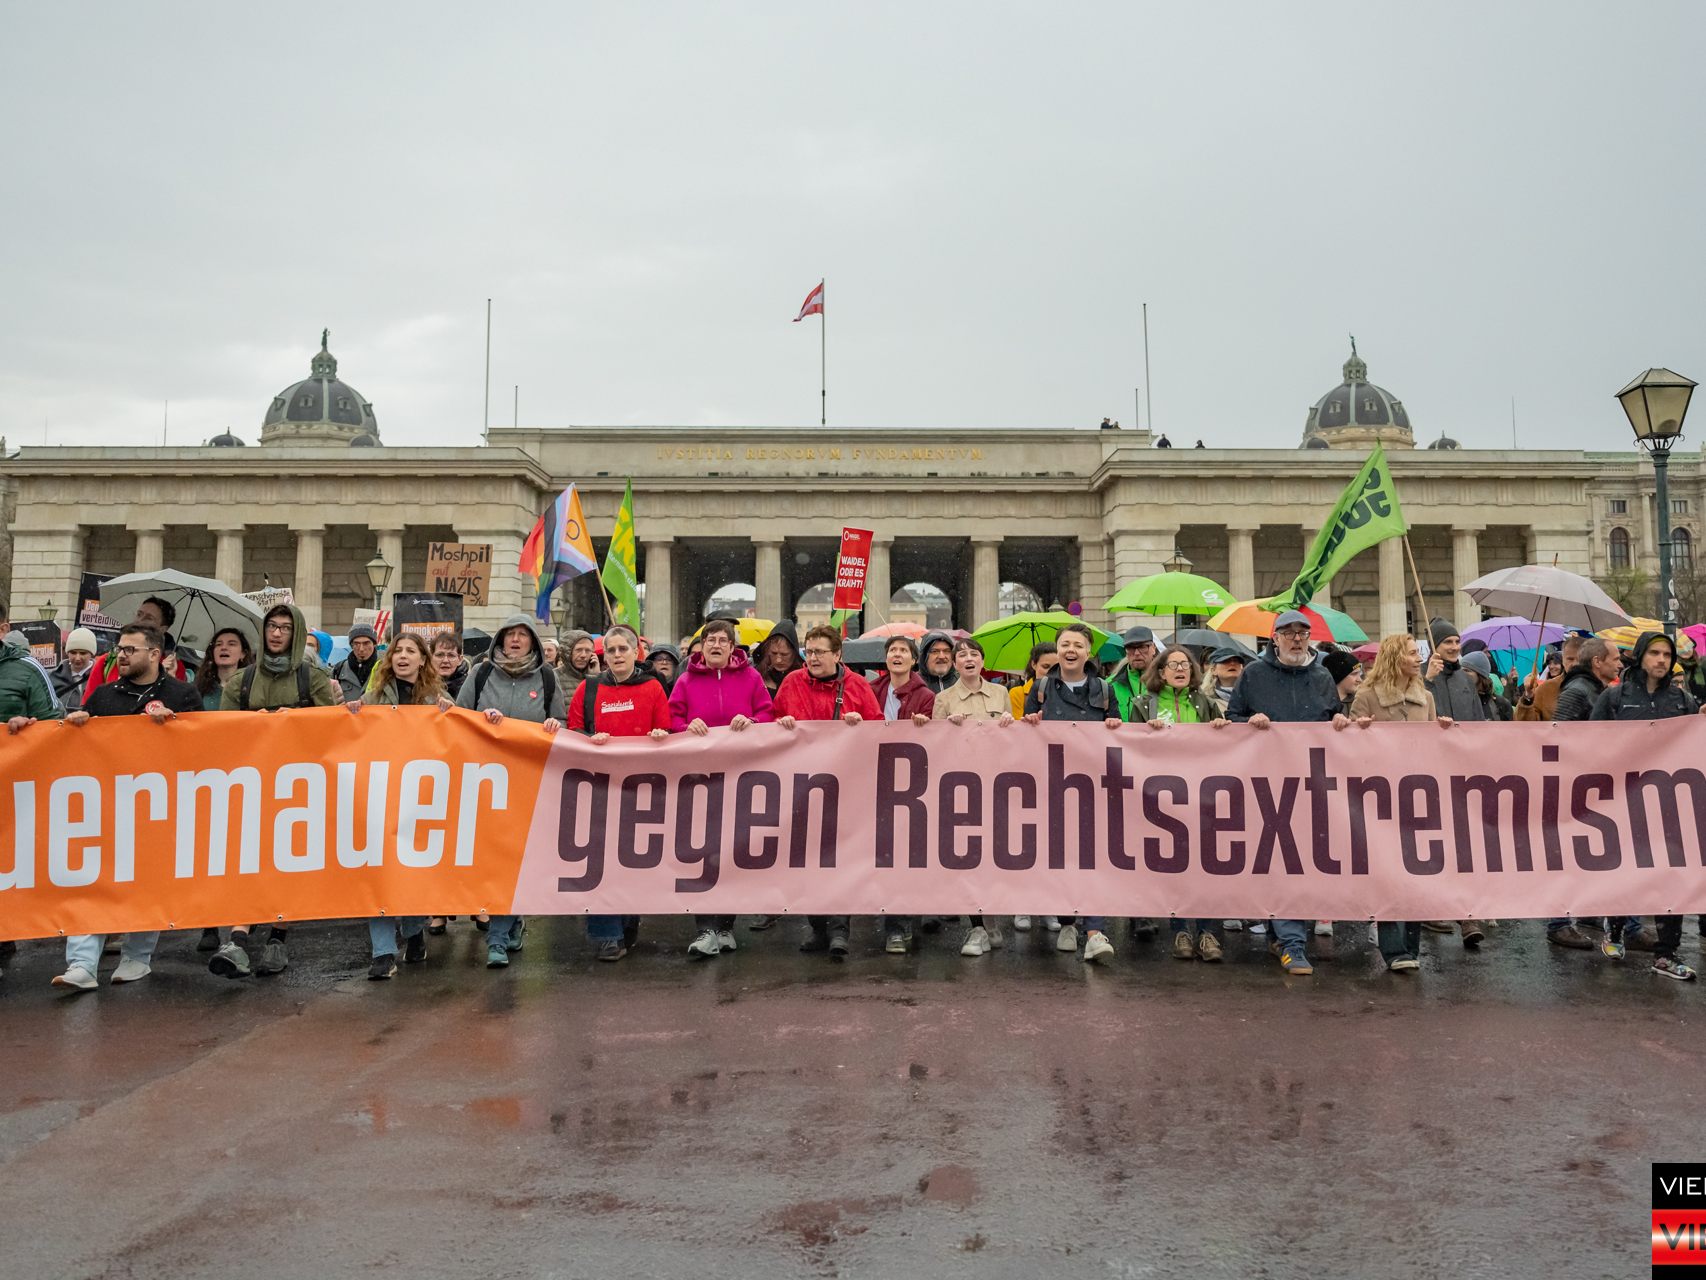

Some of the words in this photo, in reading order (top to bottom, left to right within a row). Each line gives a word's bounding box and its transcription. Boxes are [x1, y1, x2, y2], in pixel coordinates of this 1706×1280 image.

[431, 543, 491, 567] Moshpit
[432, 562, 452, 576] auf
[461, 565, 478, 576] den
[855, 569, 864, 577] ES
[436, 577, 482, 596] NAZIS
[837, 579, 863, 588] KRAHT!
[0, 759, 509, 891] uermauer
[557, 767, 840, 893] gegen
[875, 742, 1706, 876] Rechtsextremism
